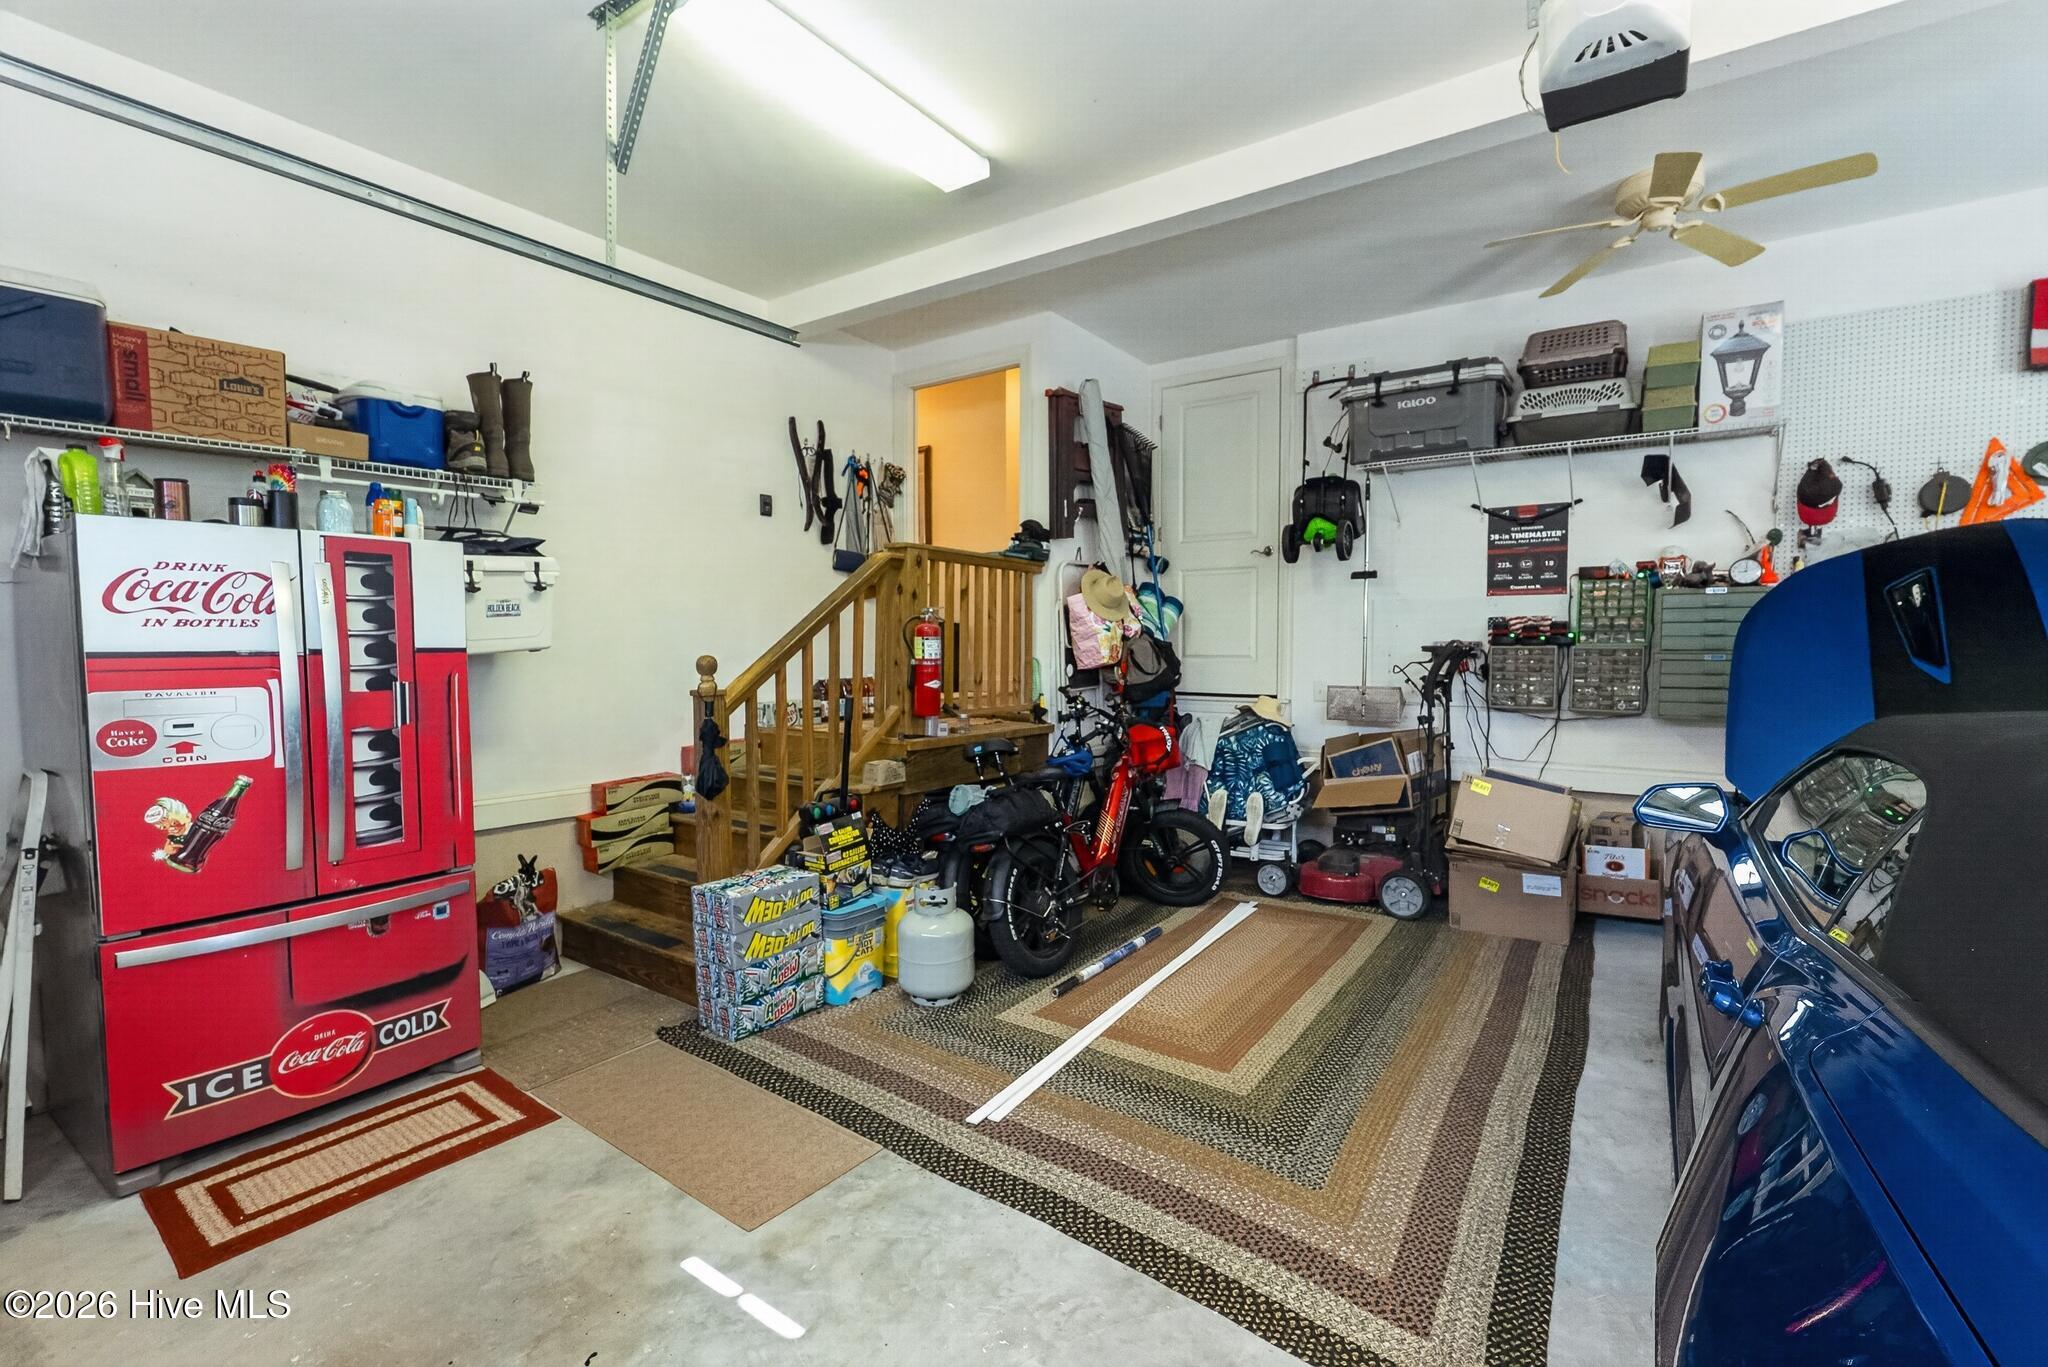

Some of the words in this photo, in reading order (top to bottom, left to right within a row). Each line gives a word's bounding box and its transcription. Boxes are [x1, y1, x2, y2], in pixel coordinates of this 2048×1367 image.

[122, 350, 146, 402] small
[1397, 396, 1437, 410] IGLOO
[153, 561, 229, 572] DRINK
[487, 604, 505, 612] HOLDEN
[505, 603, 520, 612] BEACH
[141, 618, 169, 628] IN
[173, 618, 260, 628] BOTTLES
[110, 729, 135, 737] Have
[138, 728, 145, 736] a
[105, 736, 148, 748] Coke
[162, 754, 208, 764] COIN
[1351, 763, 1382, 777] chewy
[800, 887, 814, 901] DO
[743, 895, 783, 925] DEW
[781, 895, 800, 914] THE
[802, 920, 815, 935] DO
[784, 928, 802, 948] THE
[744, 931, 785, 961] DEW
[314, 1029, 337, 1041] DRINK
[379, 1010, 438, 1046] COLD
[277, 1031, 367, 1075] Coca-Cola
[187, 1063, 264, 1107] ICE
